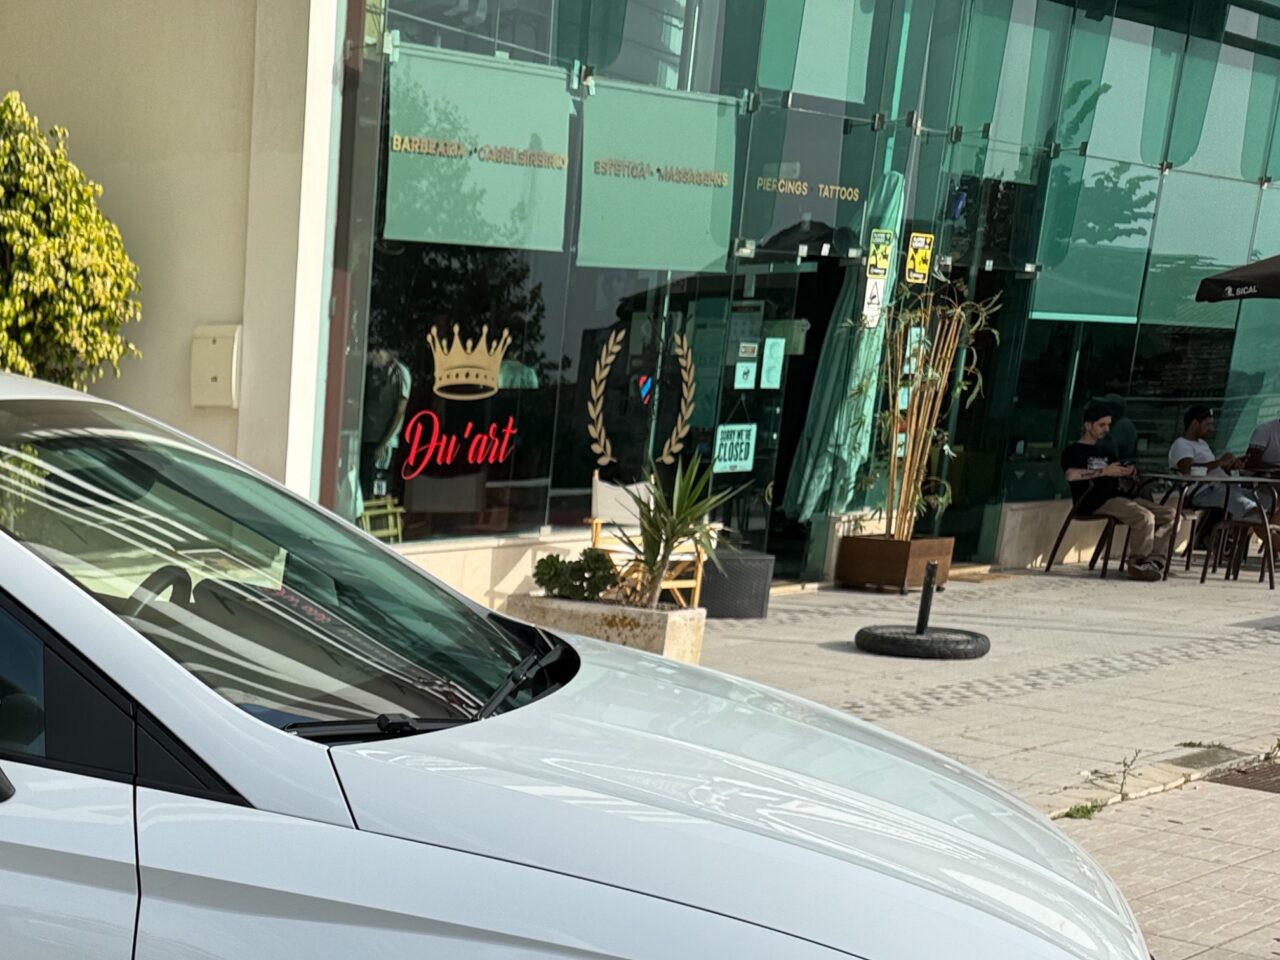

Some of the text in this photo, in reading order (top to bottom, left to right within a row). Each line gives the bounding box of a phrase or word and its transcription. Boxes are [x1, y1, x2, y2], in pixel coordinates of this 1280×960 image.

[392, 134, 465, 160] BARBEARIA
[658, 165, 728, 189] MASSAGENS
[756, 176, 860, 202] PIERCINGS TATTOOS
[1235, 285, 1258, 296] SICAL
[401, 409, 518, 481] Du'art
[718, 441, 751, 462] CLOSED
